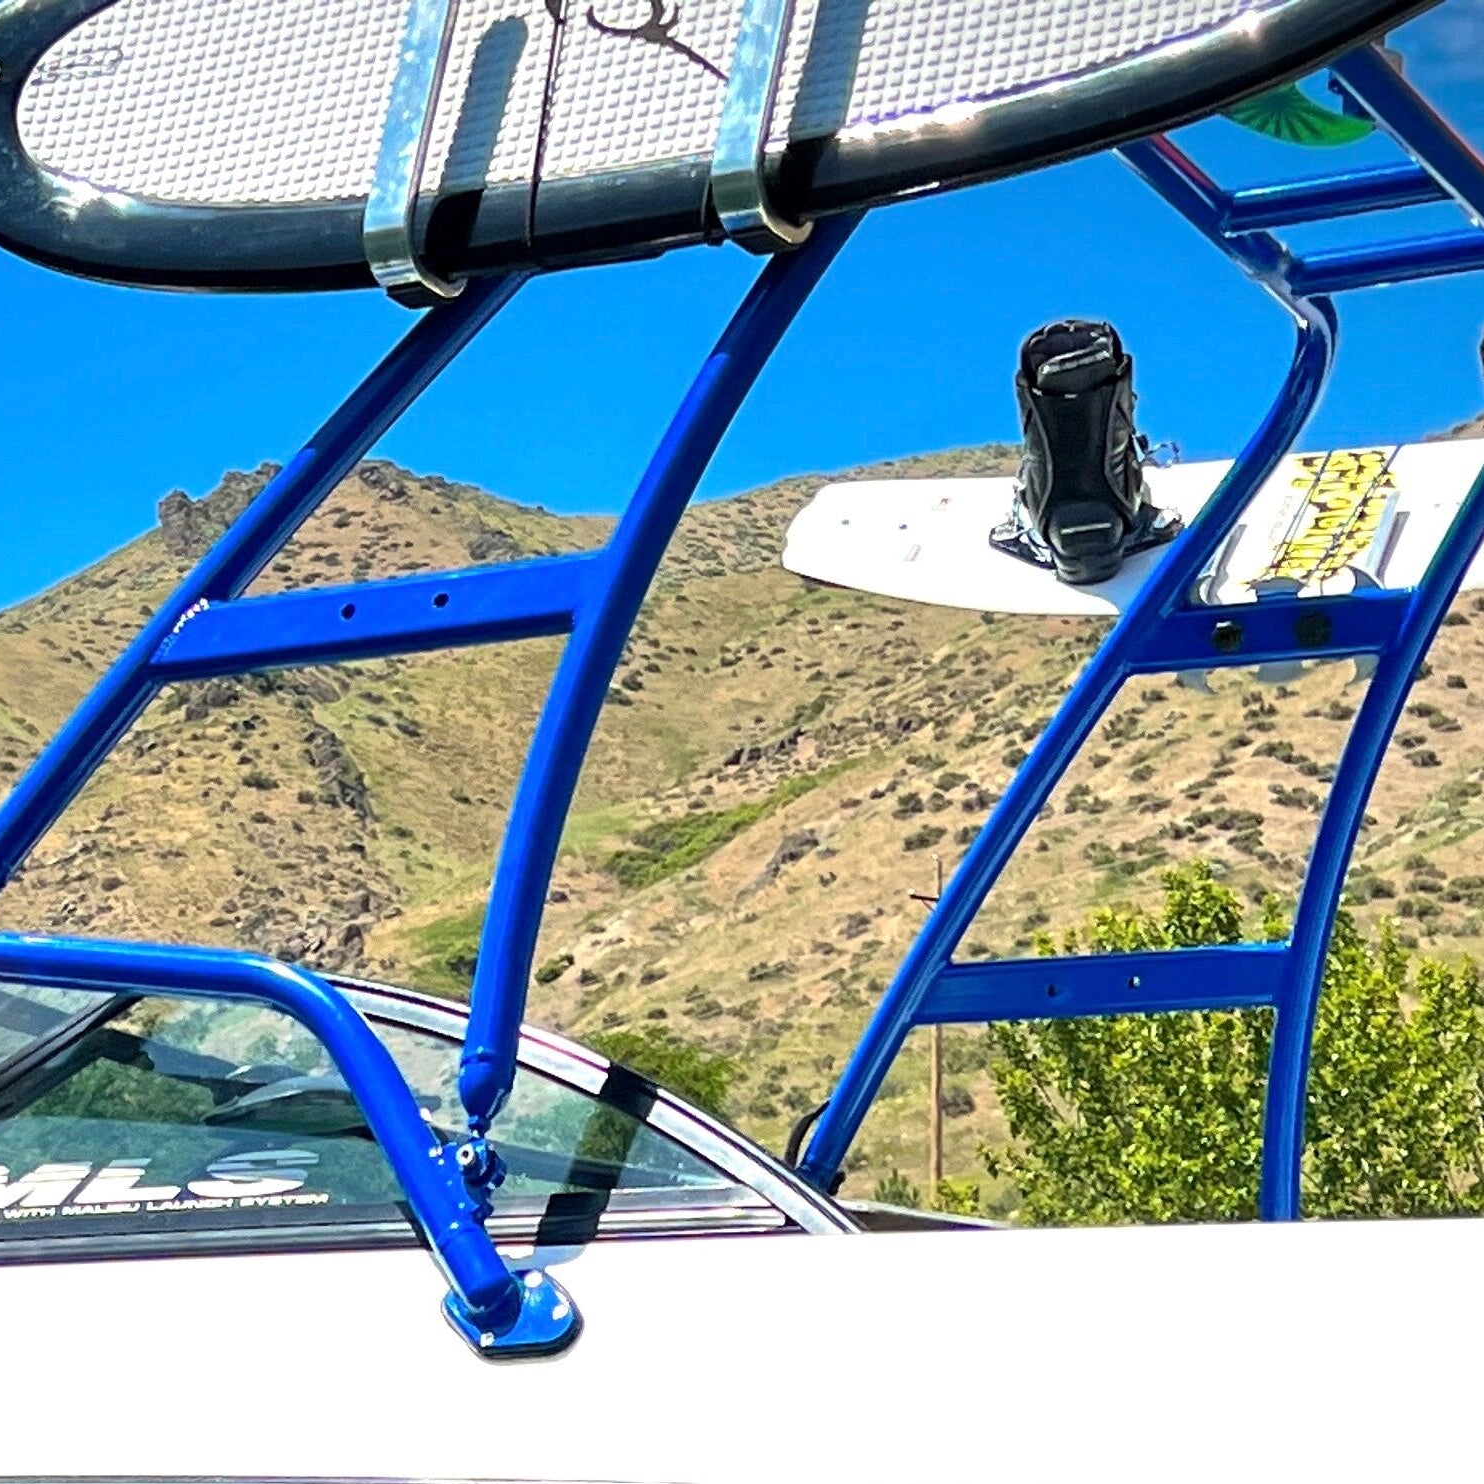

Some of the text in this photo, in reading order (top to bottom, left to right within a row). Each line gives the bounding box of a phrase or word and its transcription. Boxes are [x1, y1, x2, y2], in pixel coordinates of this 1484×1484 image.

[3, 1207, 56, 1219] WITH
[146, 1198, 234, 1211] LAUNCH
[240, 1193, 329, 1206] SYSTEM
